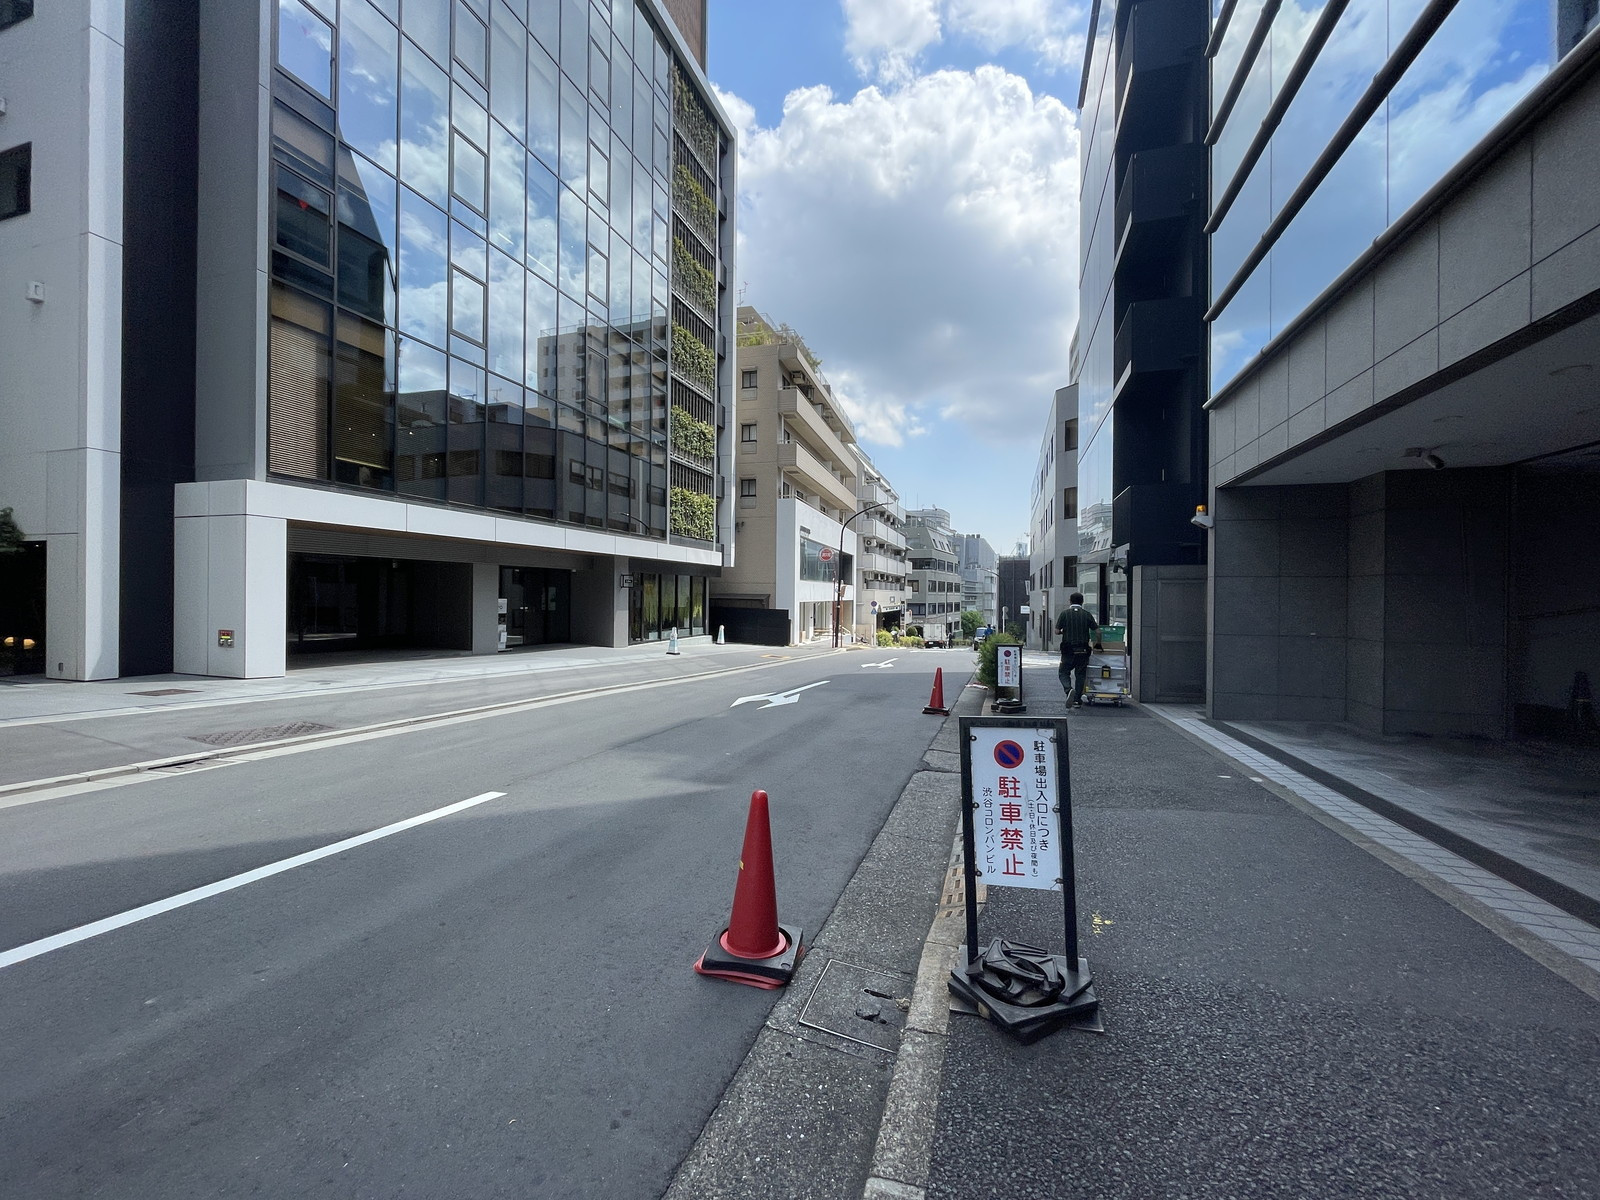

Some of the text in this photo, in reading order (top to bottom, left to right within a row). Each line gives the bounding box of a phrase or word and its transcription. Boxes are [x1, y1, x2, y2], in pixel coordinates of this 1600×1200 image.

[982, 787, 996, 874] 渋谷コロンバンビル
[998, 776, 1025, 877] 駐車禁止
[1033, 740, 1050, 851] 駐車場出入口につき
